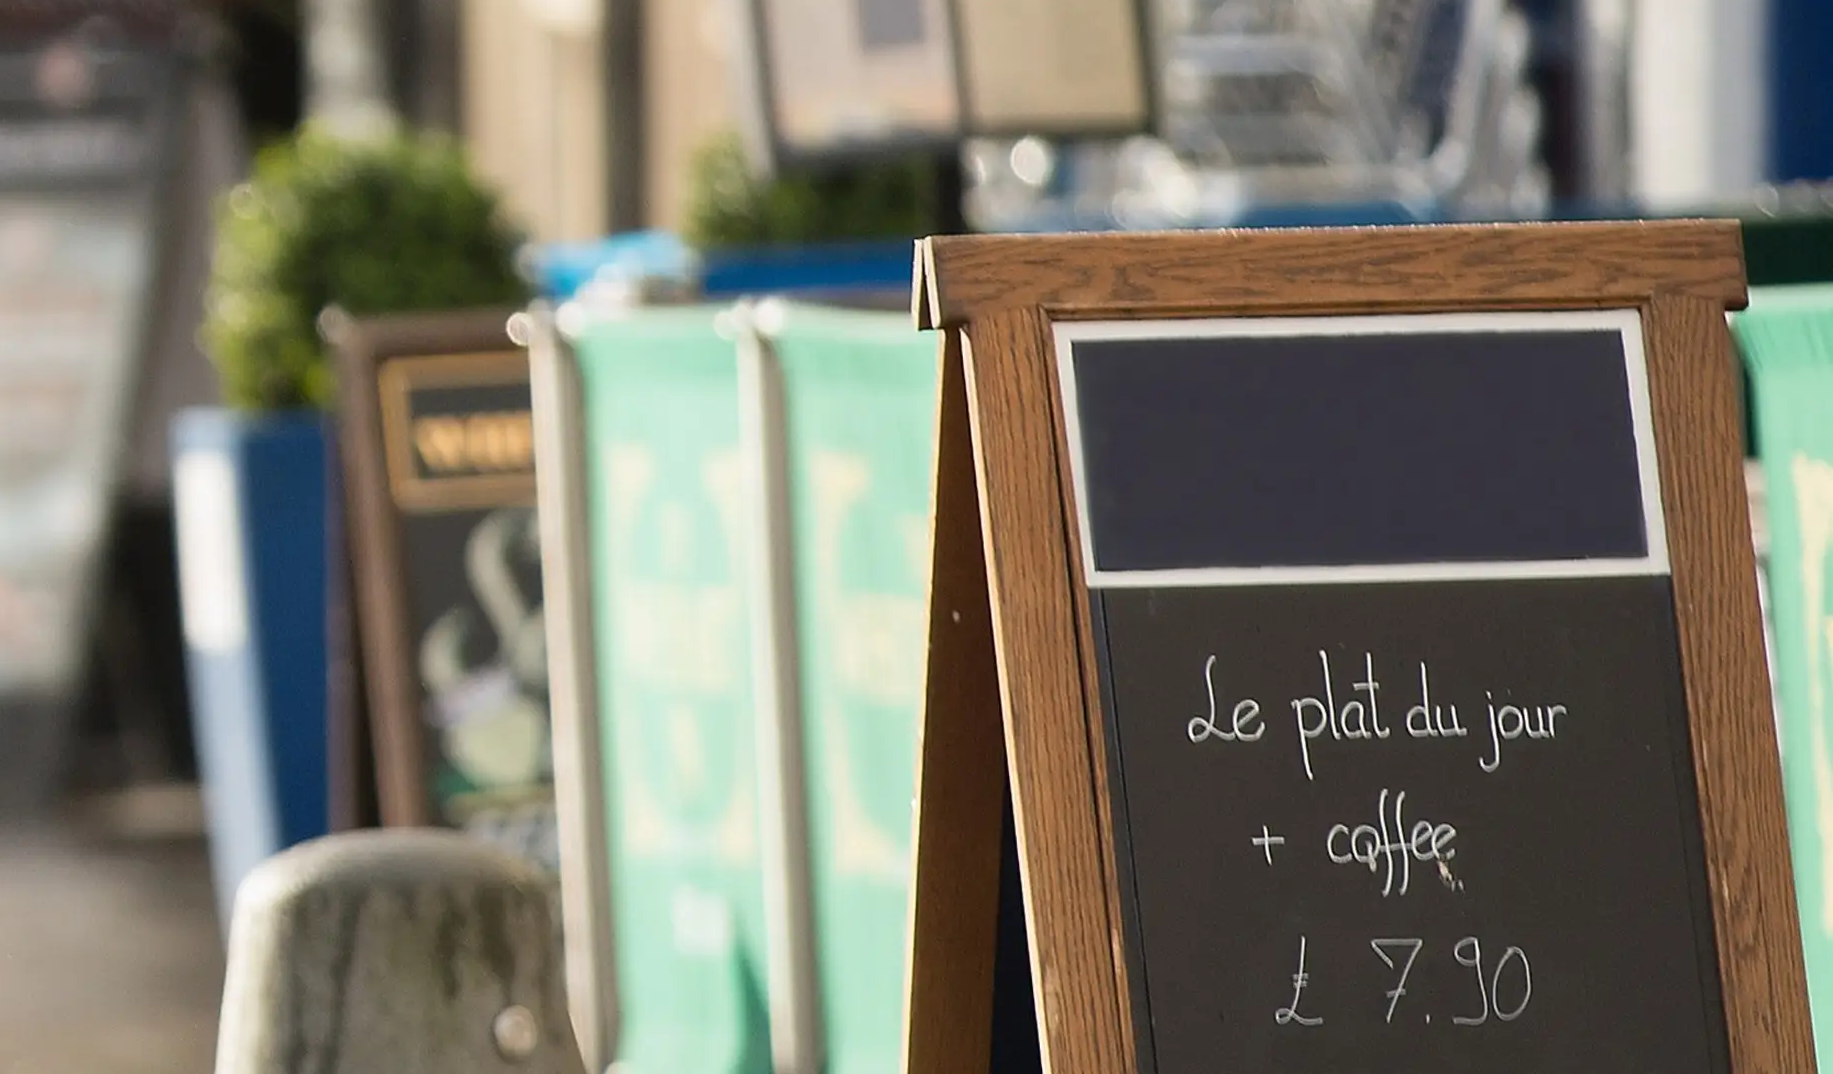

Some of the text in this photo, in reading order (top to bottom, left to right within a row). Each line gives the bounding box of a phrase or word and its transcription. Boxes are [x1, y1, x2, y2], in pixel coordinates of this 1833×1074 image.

[1187, 648, 1569, 782] Le plat du jour
[1250, 787, 1459, 898] + coffee
[1273, 934, 1533, 1026] £ 7.90
